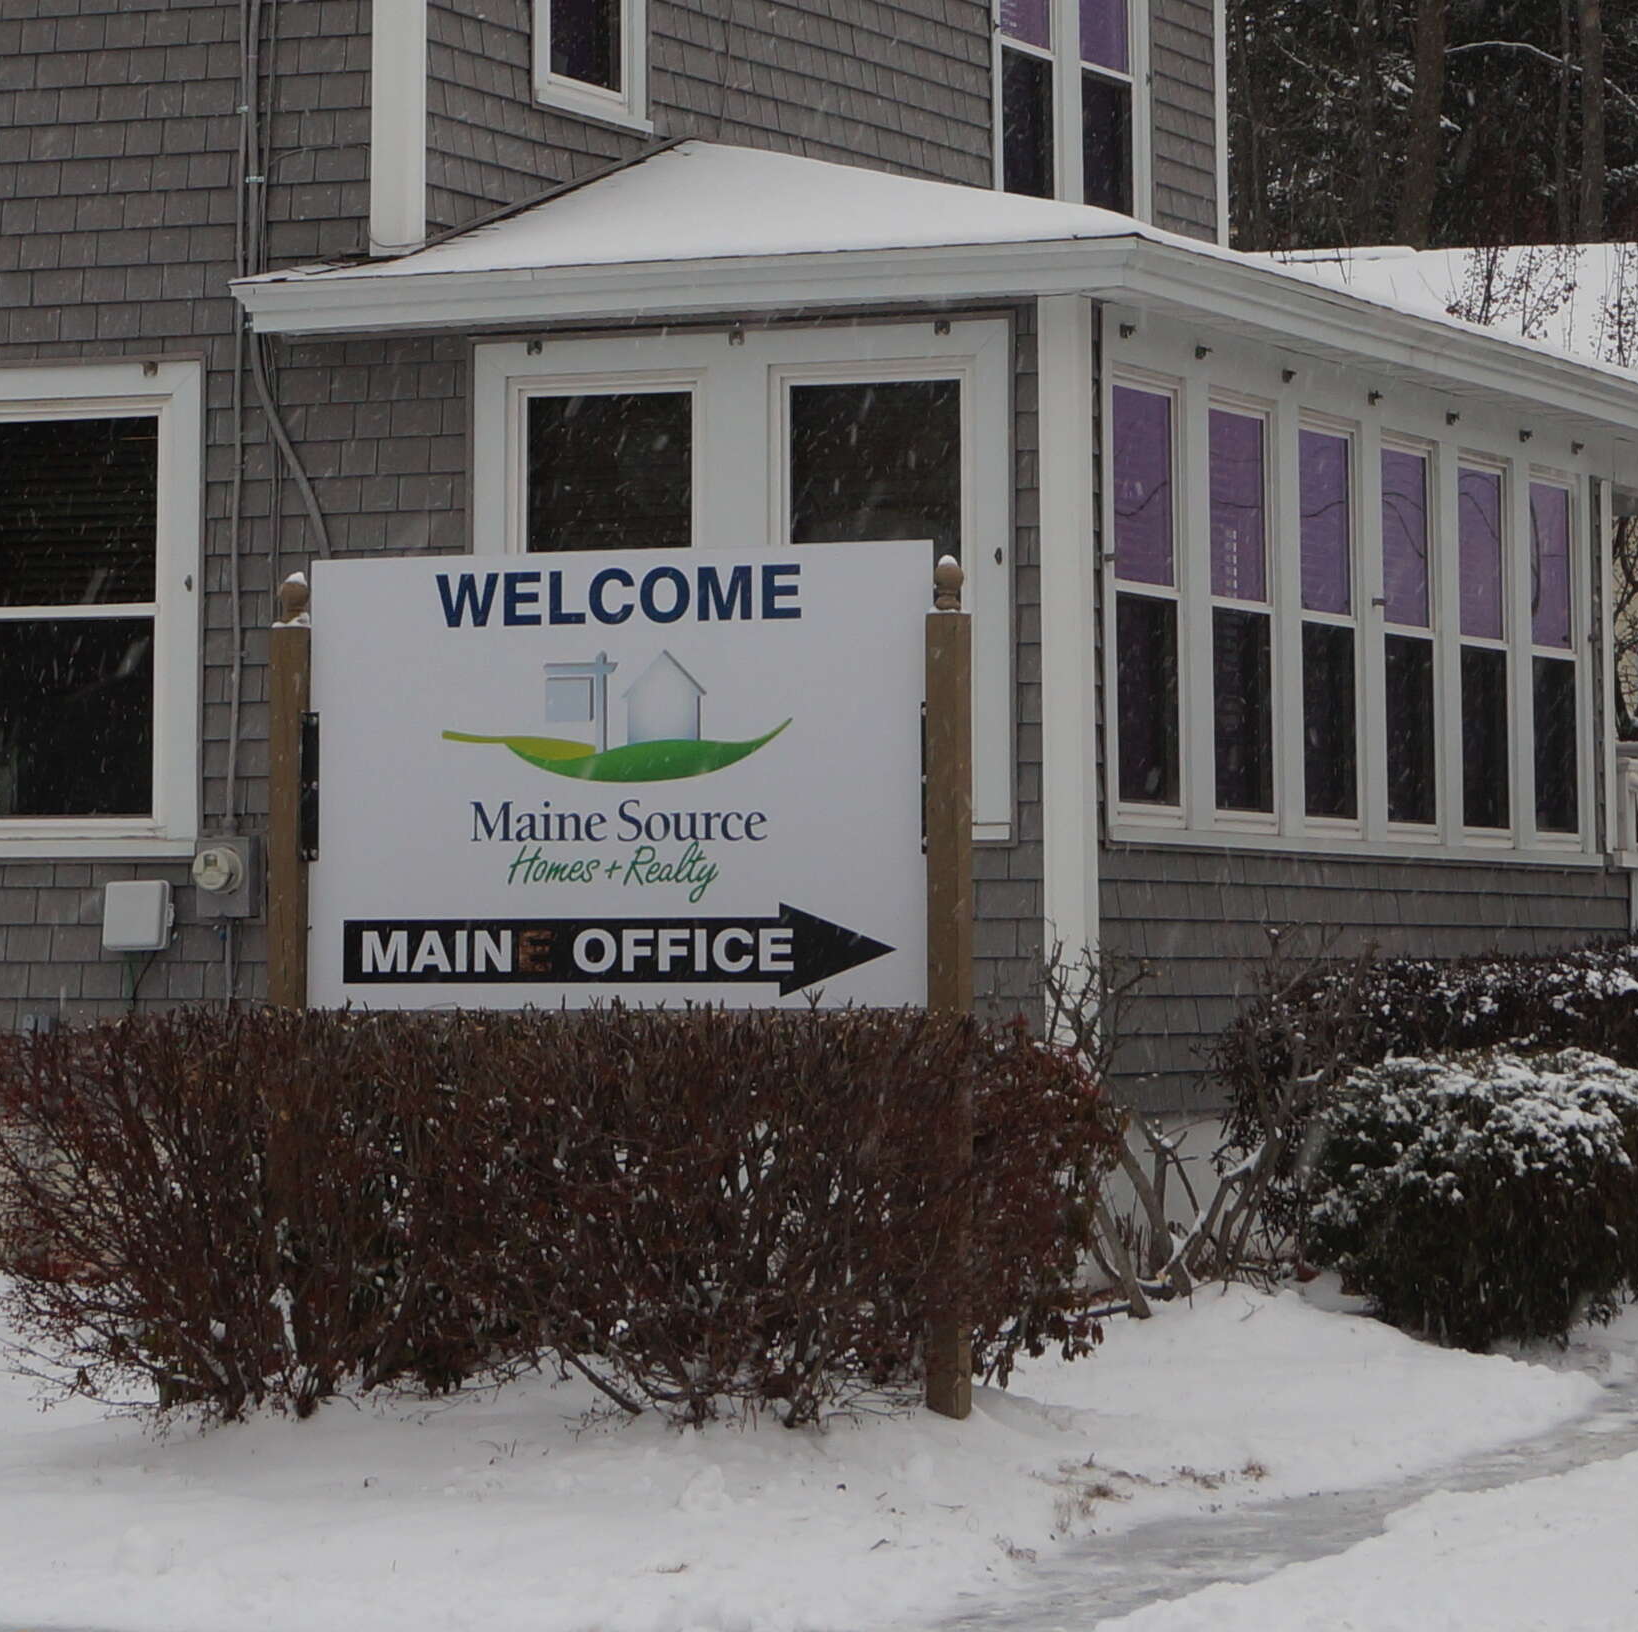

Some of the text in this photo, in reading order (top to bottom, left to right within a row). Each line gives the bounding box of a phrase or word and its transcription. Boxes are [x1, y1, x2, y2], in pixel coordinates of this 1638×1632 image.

[435, 563, 802, 628] WELCOME
[470, 799, 768, 844] Maine Source
[508, 844, 601, 885] Homes
[622, 841, 719, 903] Realty
[573, 927, 794, 973] OFFICE
